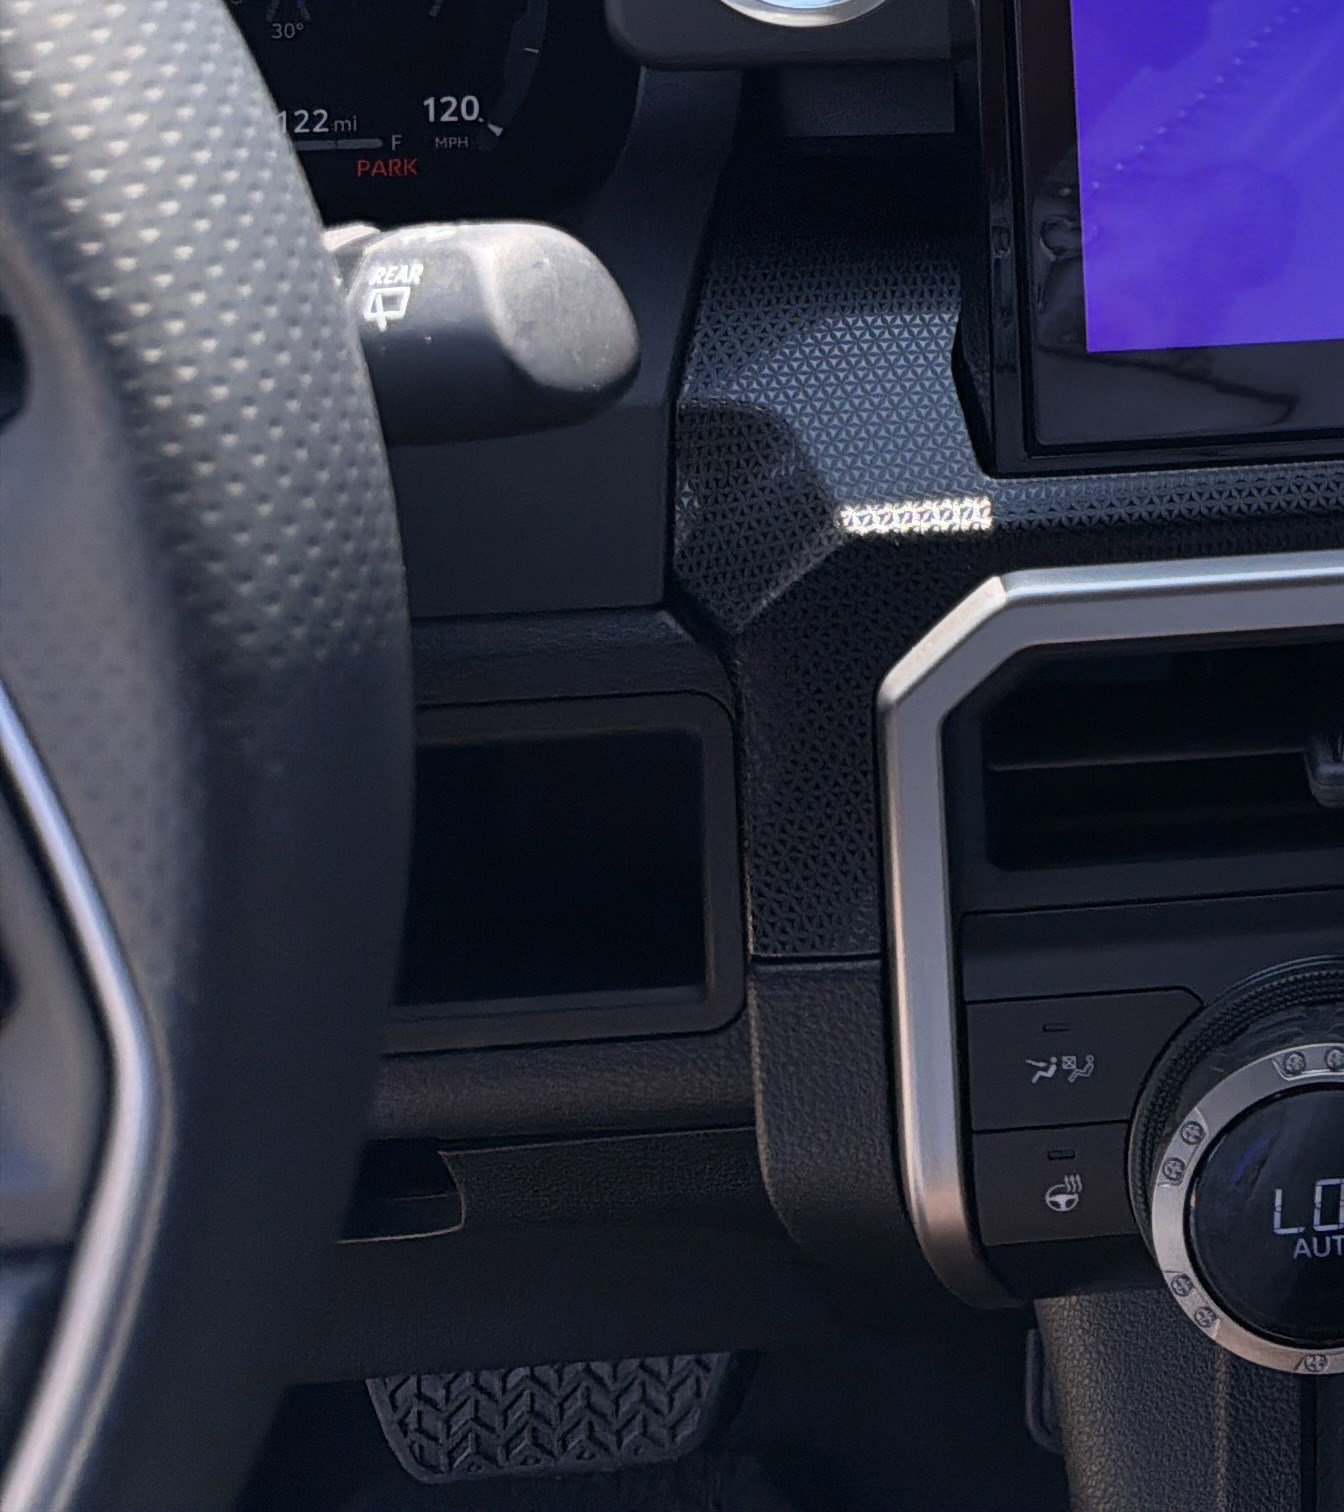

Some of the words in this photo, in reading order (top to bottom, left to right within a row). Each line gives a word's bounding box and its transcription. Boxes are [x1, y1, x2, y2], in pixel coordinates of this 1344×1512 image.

[422, 94, 481, 123] 120
[333, 114, 358, 133] mi
[390, 134, 403, 151] F
[434, 135, 470, 150] MPH
[356, 158, 419, 178] PARK
[368, 261, 424, 286] REAR
